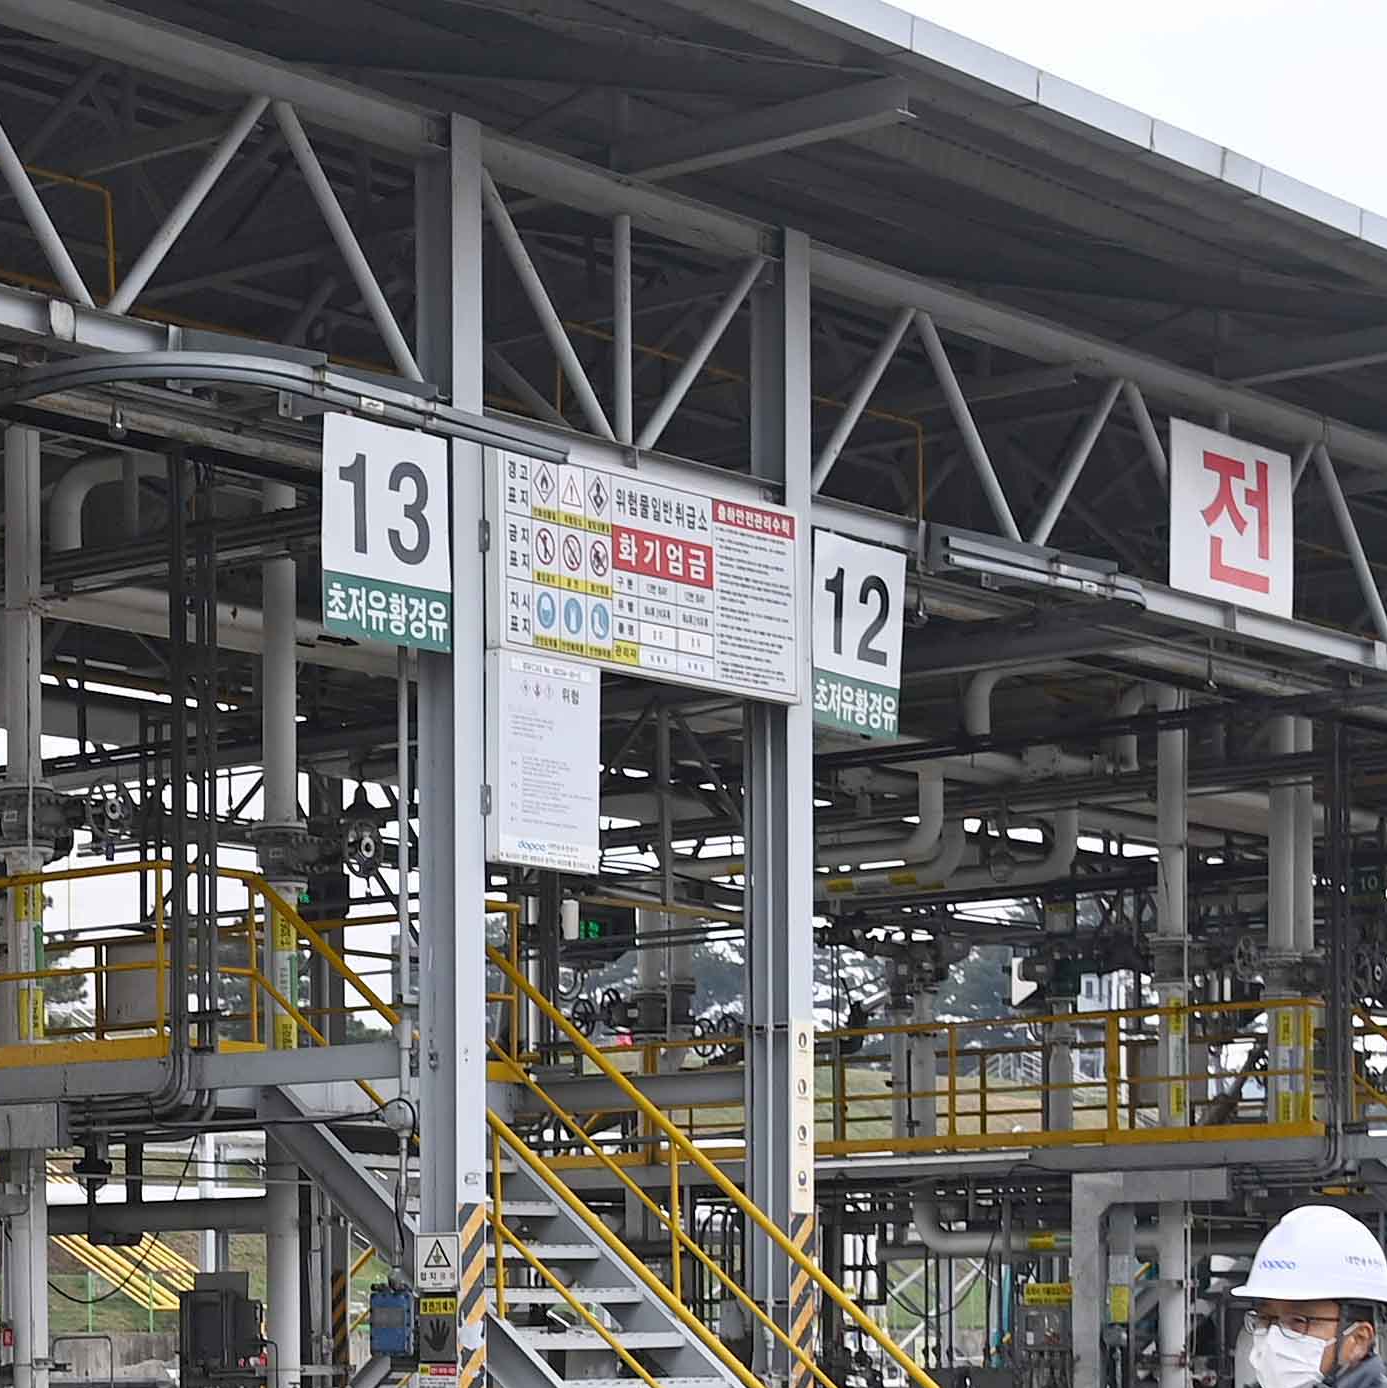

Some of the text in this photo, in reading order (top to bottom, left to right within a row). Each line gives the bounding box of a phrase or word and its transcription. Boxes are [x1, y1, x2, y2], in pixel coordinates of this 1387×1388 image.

[338, 452, 430, 566] 13
[615, 487, 709, 532] 위험물일반취급소
[1200, 450, 1271, 594] 전
[618, 531, 708, 581] 화기엄금
[326, 582, 448, 642] 초저유황경유
[824, 566, 889, 666] 12
[813, 678, 897, 732] 초저유황경유
